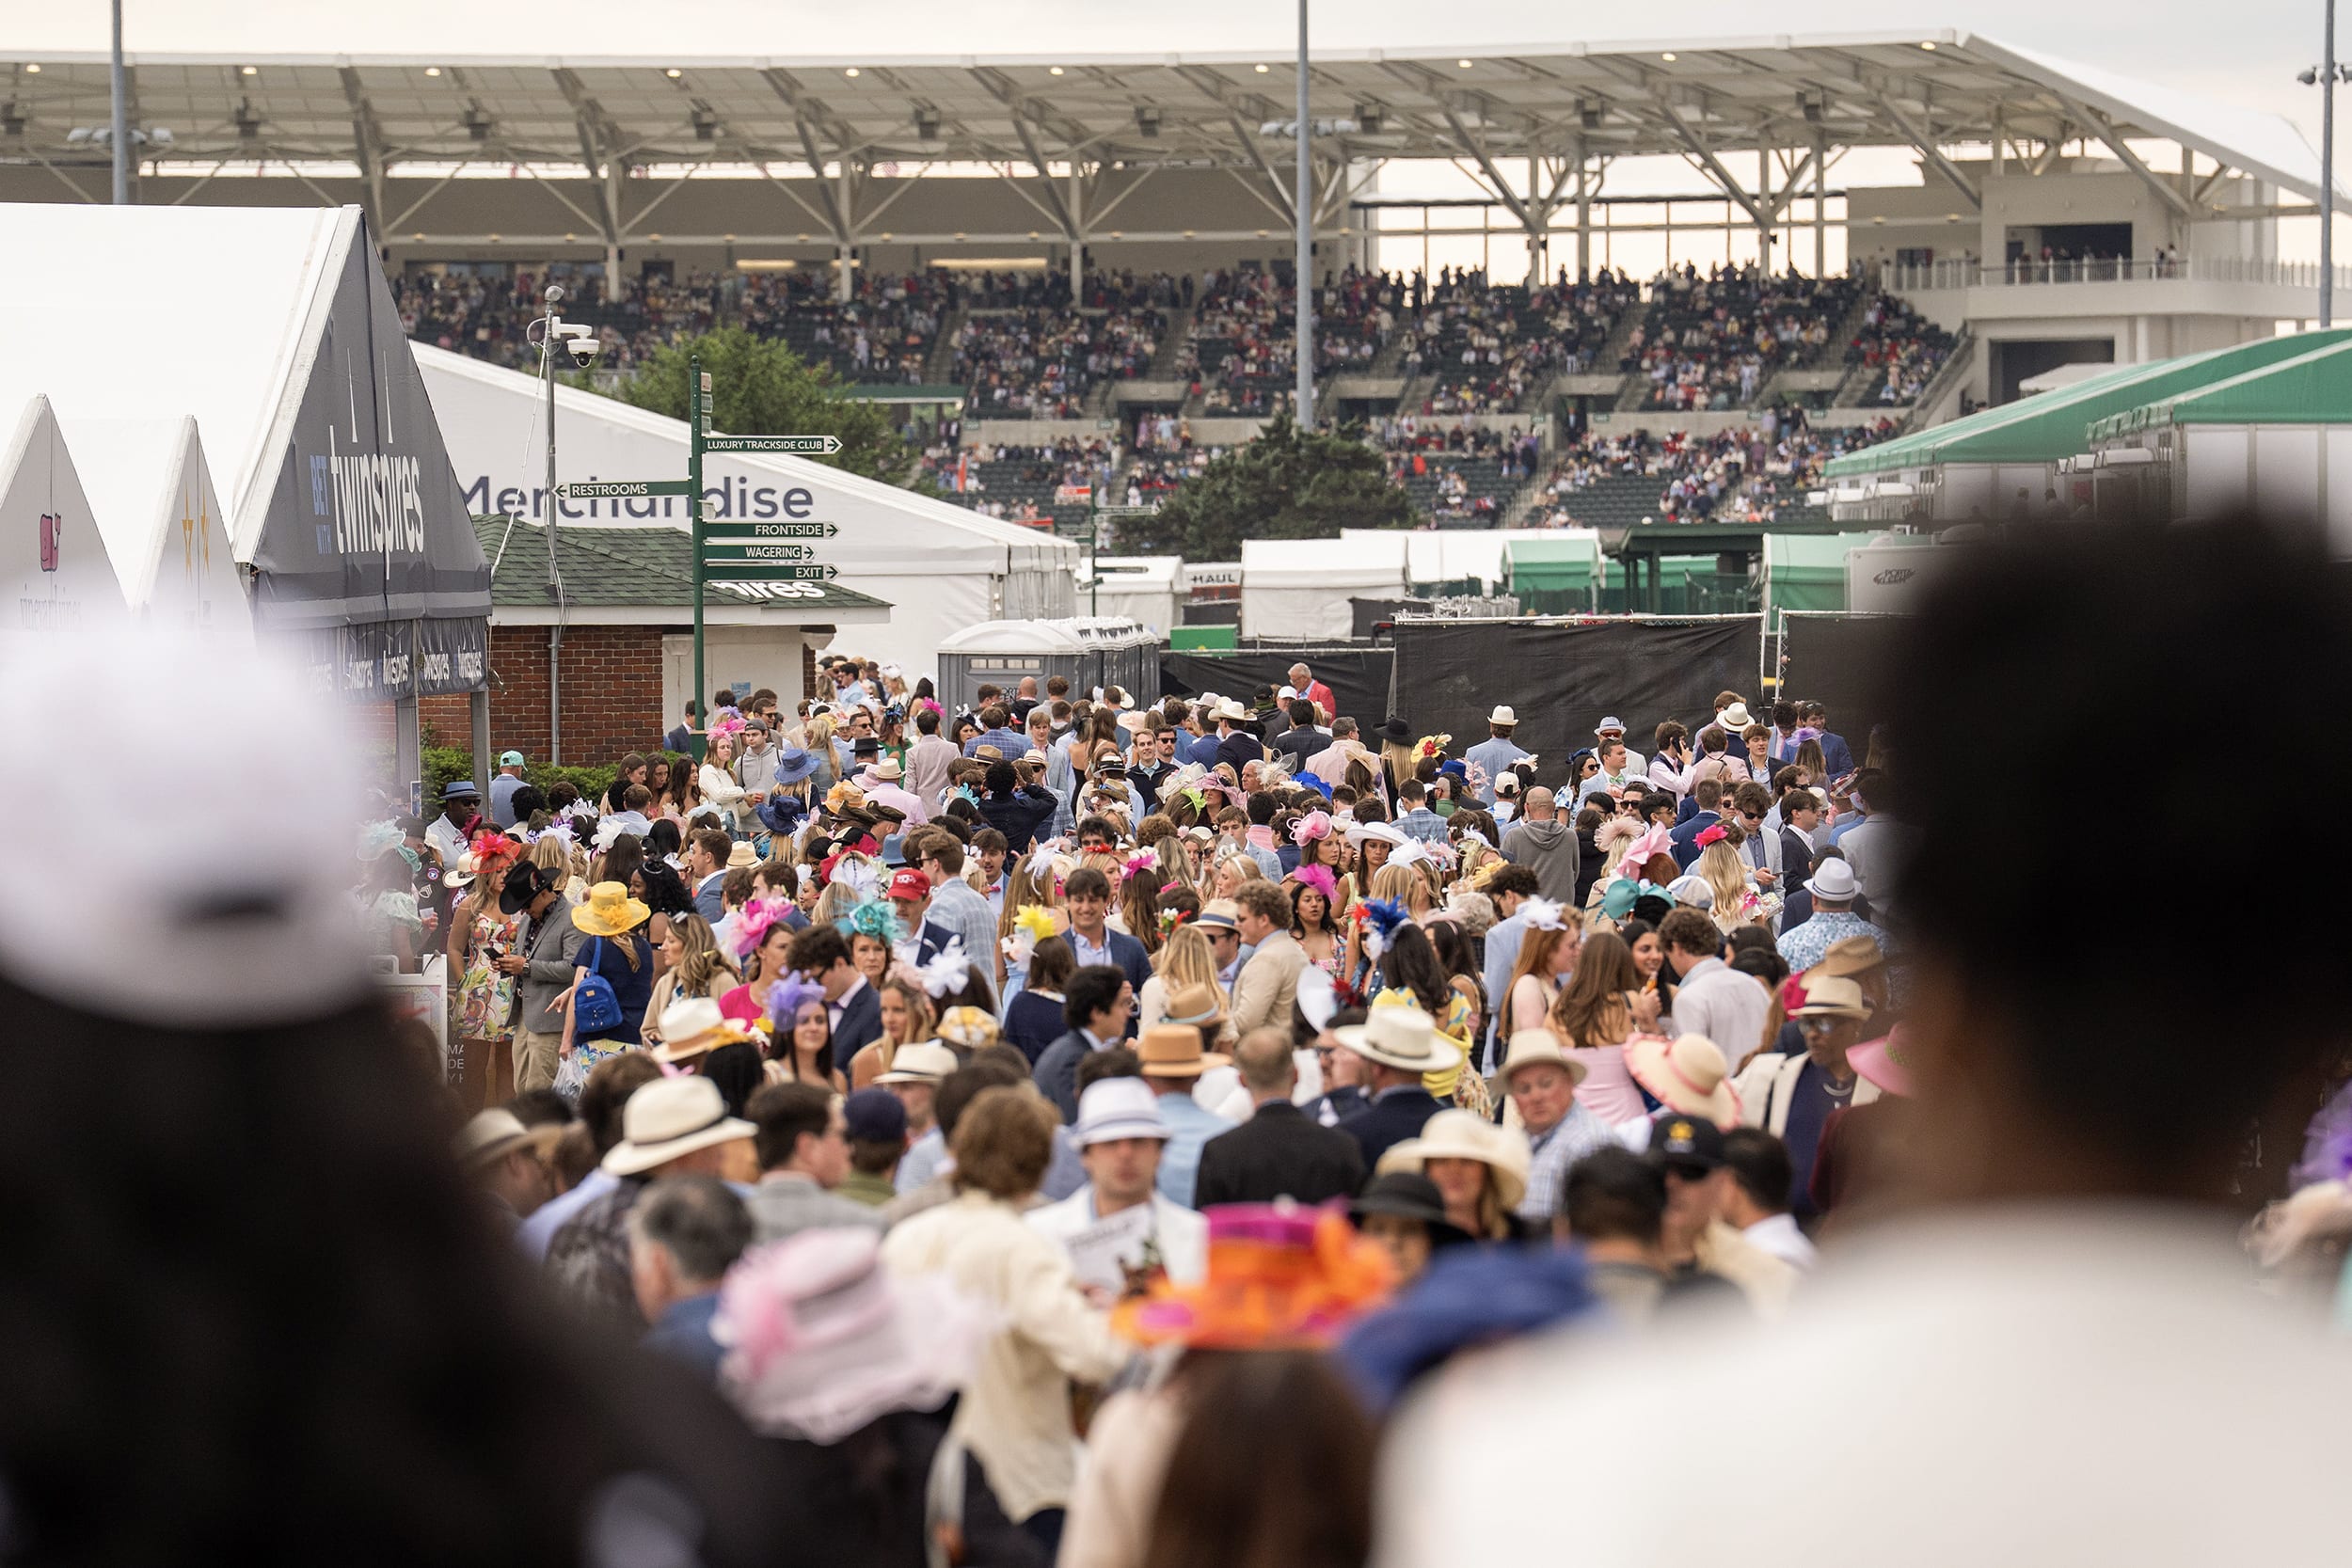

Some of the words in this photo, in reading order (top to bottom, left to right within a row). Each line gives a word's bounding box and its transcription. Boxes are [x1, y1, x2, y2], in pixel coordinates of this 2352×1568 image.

[707, 440, 744, 450] LUXURY
[745, 440, 796, 450] TRACKSIDE
[797, 440, 823, 450] CLUB
[571, 483, 648, 496] RESTROOMS
[329, 425, 424, 580] twinspires
[755, 525, 821, 535] FRONTSIDE
[745, 546, 801, 558] WAGERING
[795, 567, 822, 578] EXIT
